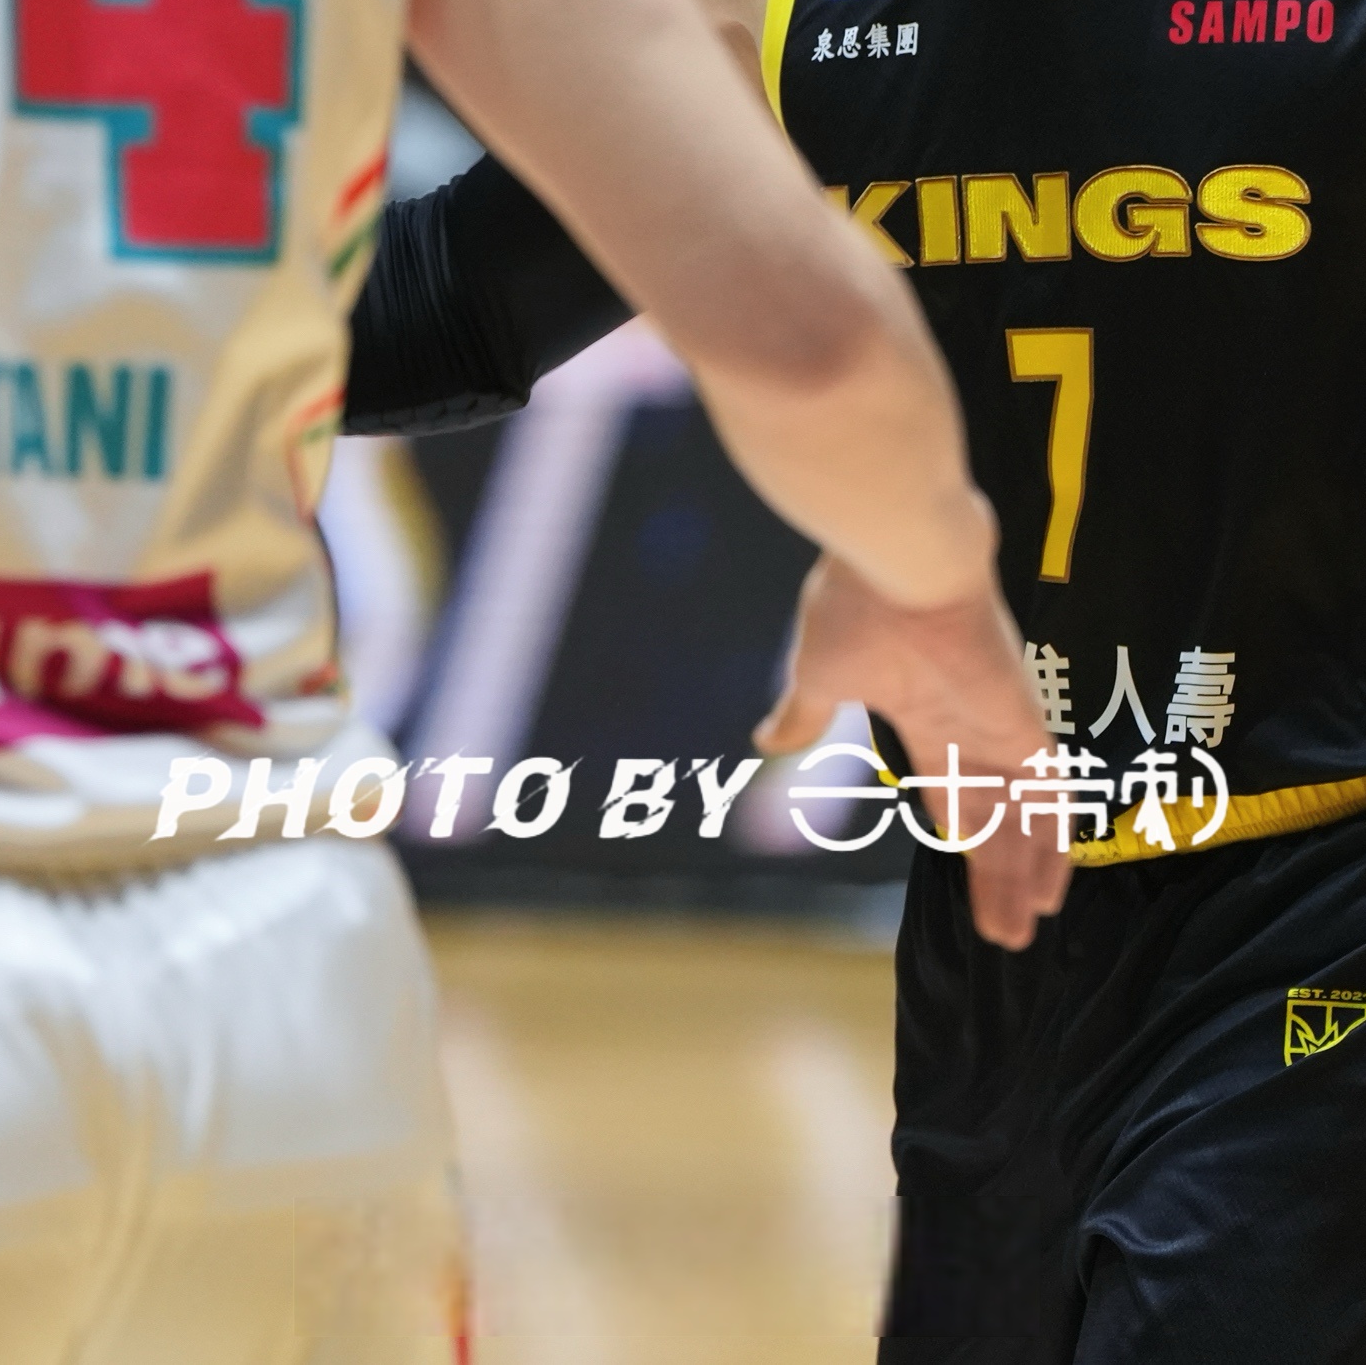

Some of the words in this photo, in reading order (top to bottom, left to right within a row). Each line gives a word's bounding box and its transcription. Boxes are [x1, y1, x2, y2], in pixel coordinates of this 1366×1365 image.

[810, 21, 920, 64] 泉恩集團
[824, 164, 1312, 268] KINGS
[1005, 327, 1094, 584] 7
[1287, 988, 1327, 999] EST.
